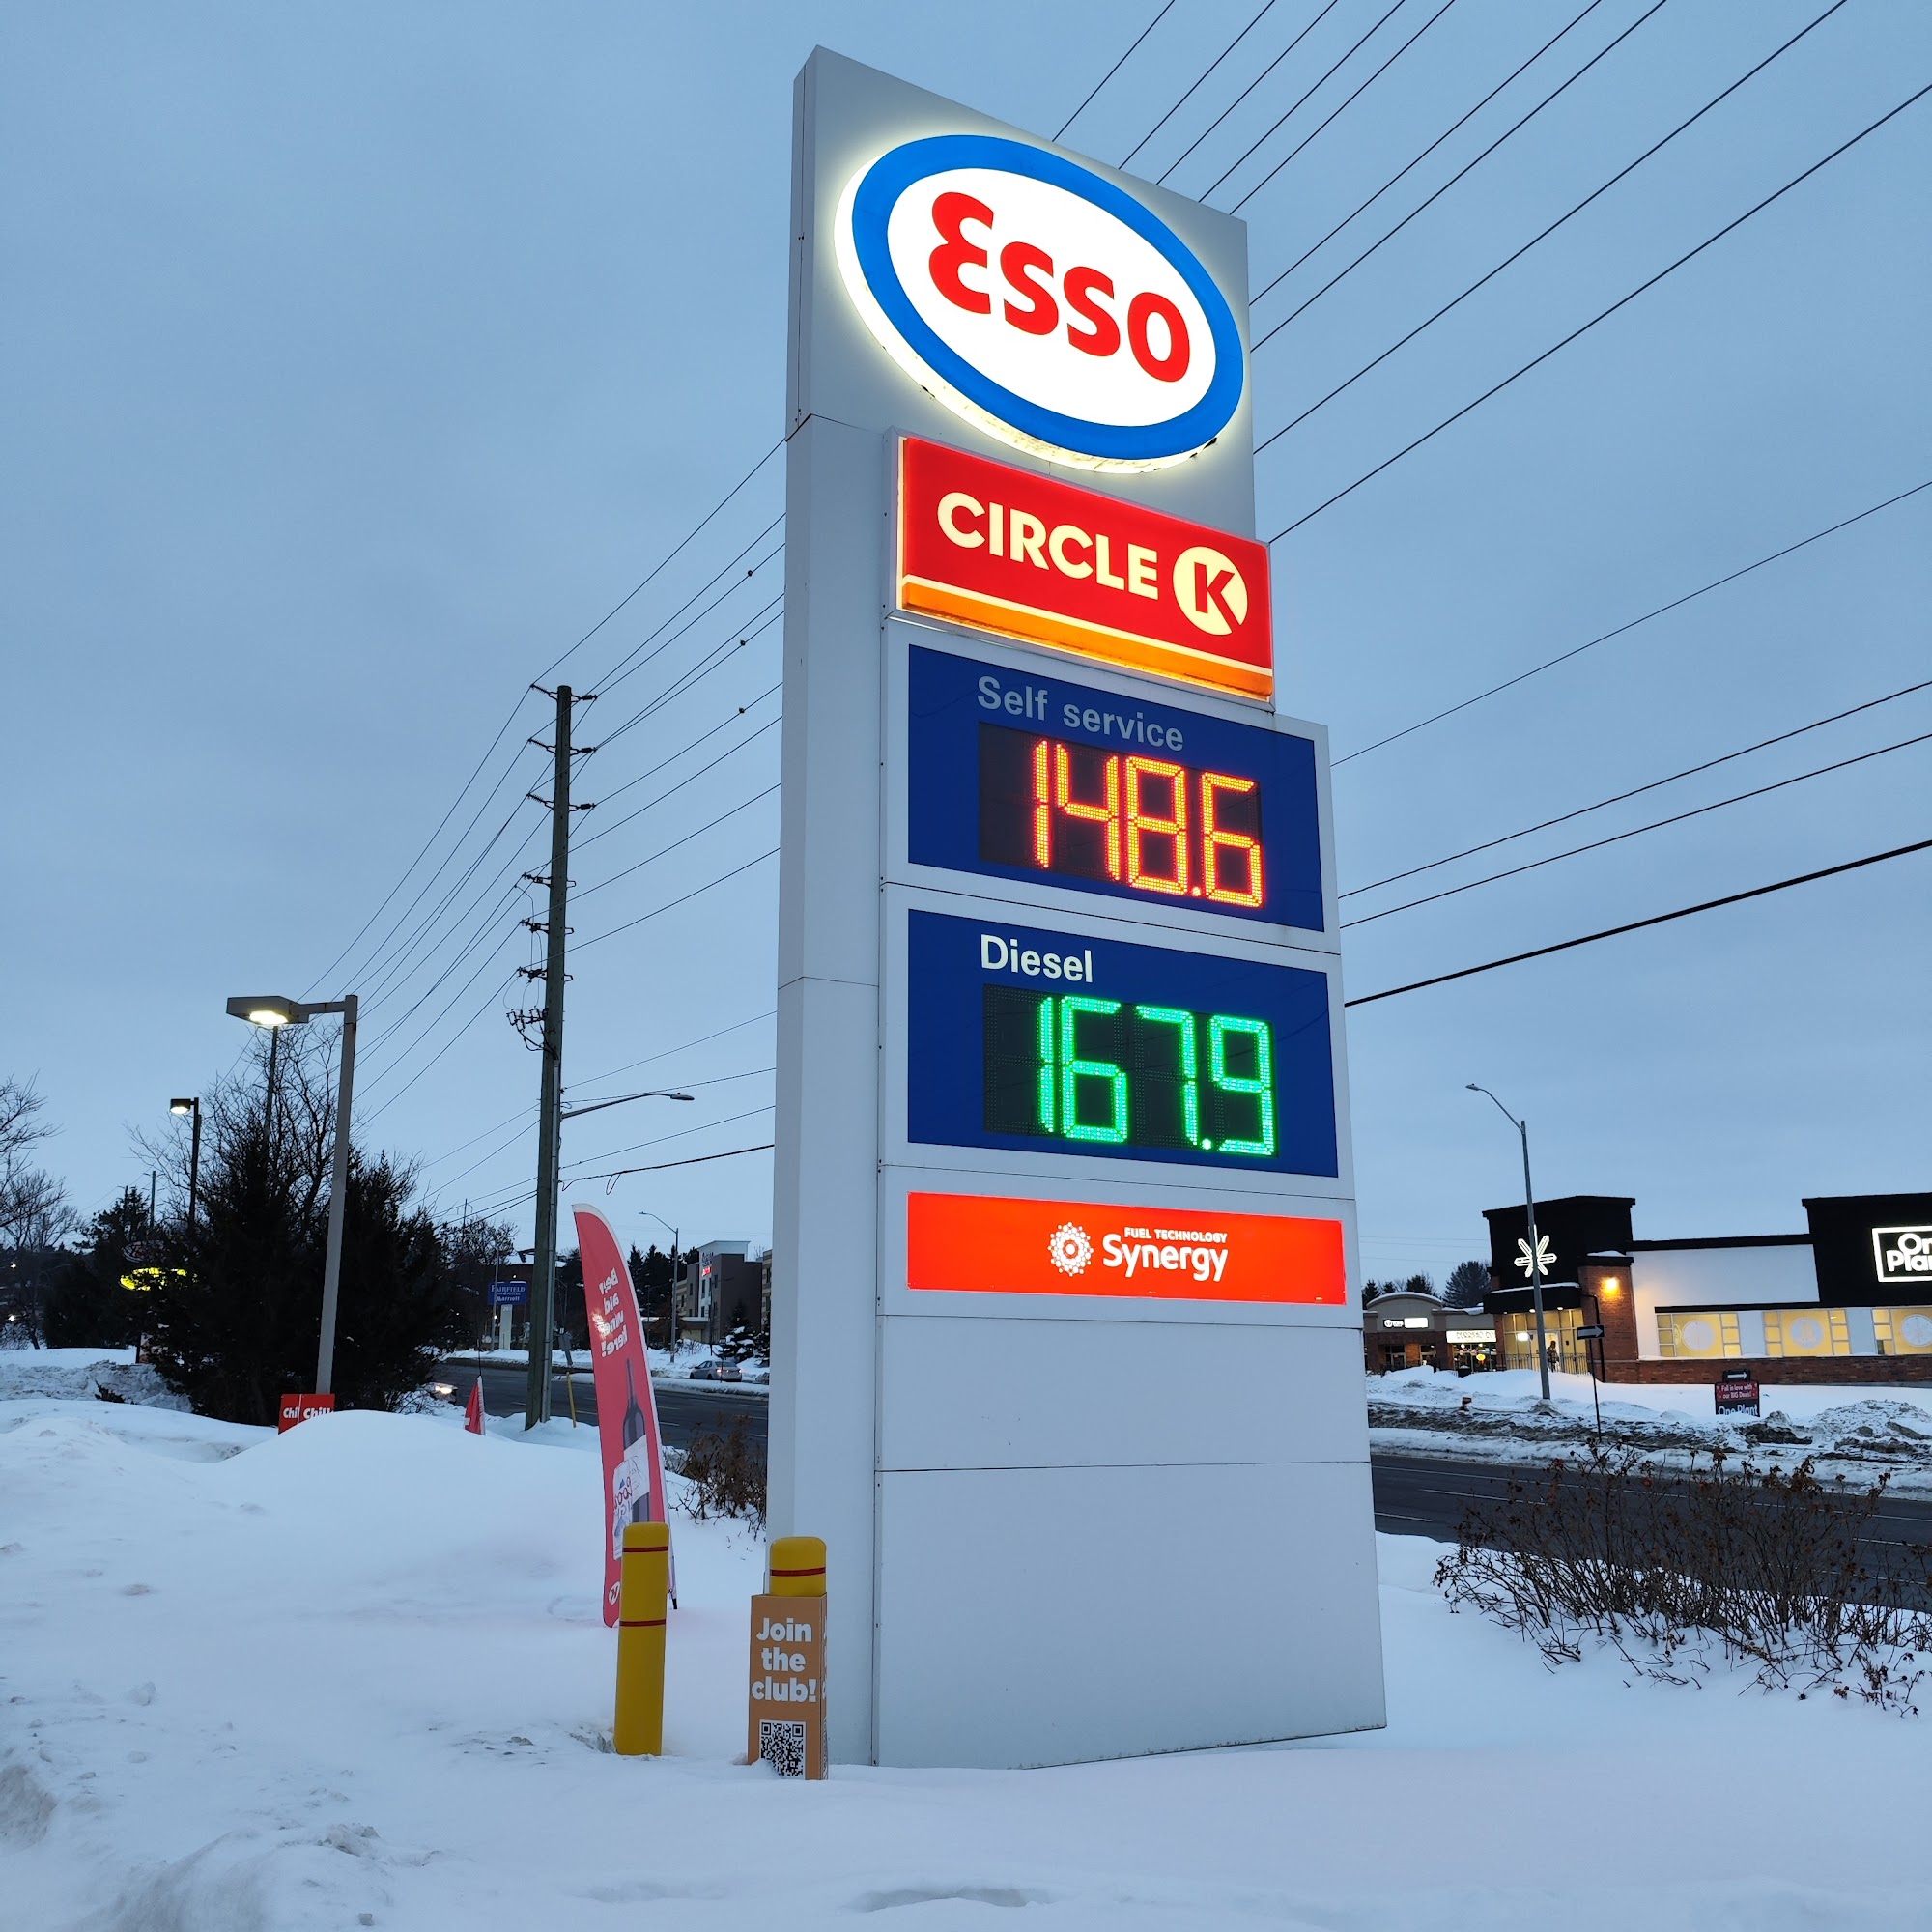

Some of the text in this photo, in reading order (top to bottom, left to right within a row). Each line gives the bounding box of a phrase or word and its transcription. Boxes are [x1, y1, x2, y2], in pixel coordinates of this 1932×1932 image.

[937, 492, 1159, 601] CIRCLE
[977, 675, 1184, 752] Self service
[1034, 740, 1264, 909] 148.6
[980, 934, 1094, 983] Diesel
[1037, 995, 1275, 1156] 167.9
[1102, 1234, 1229, 1283] Synergy
[1124, 1227, 1228, 1244] FUEL TECHNOLOGY
[756, 1617, 811, 1642] Join
[761, 1647, 806, 1672] the
[751, 1676, 817, 1703] club!
